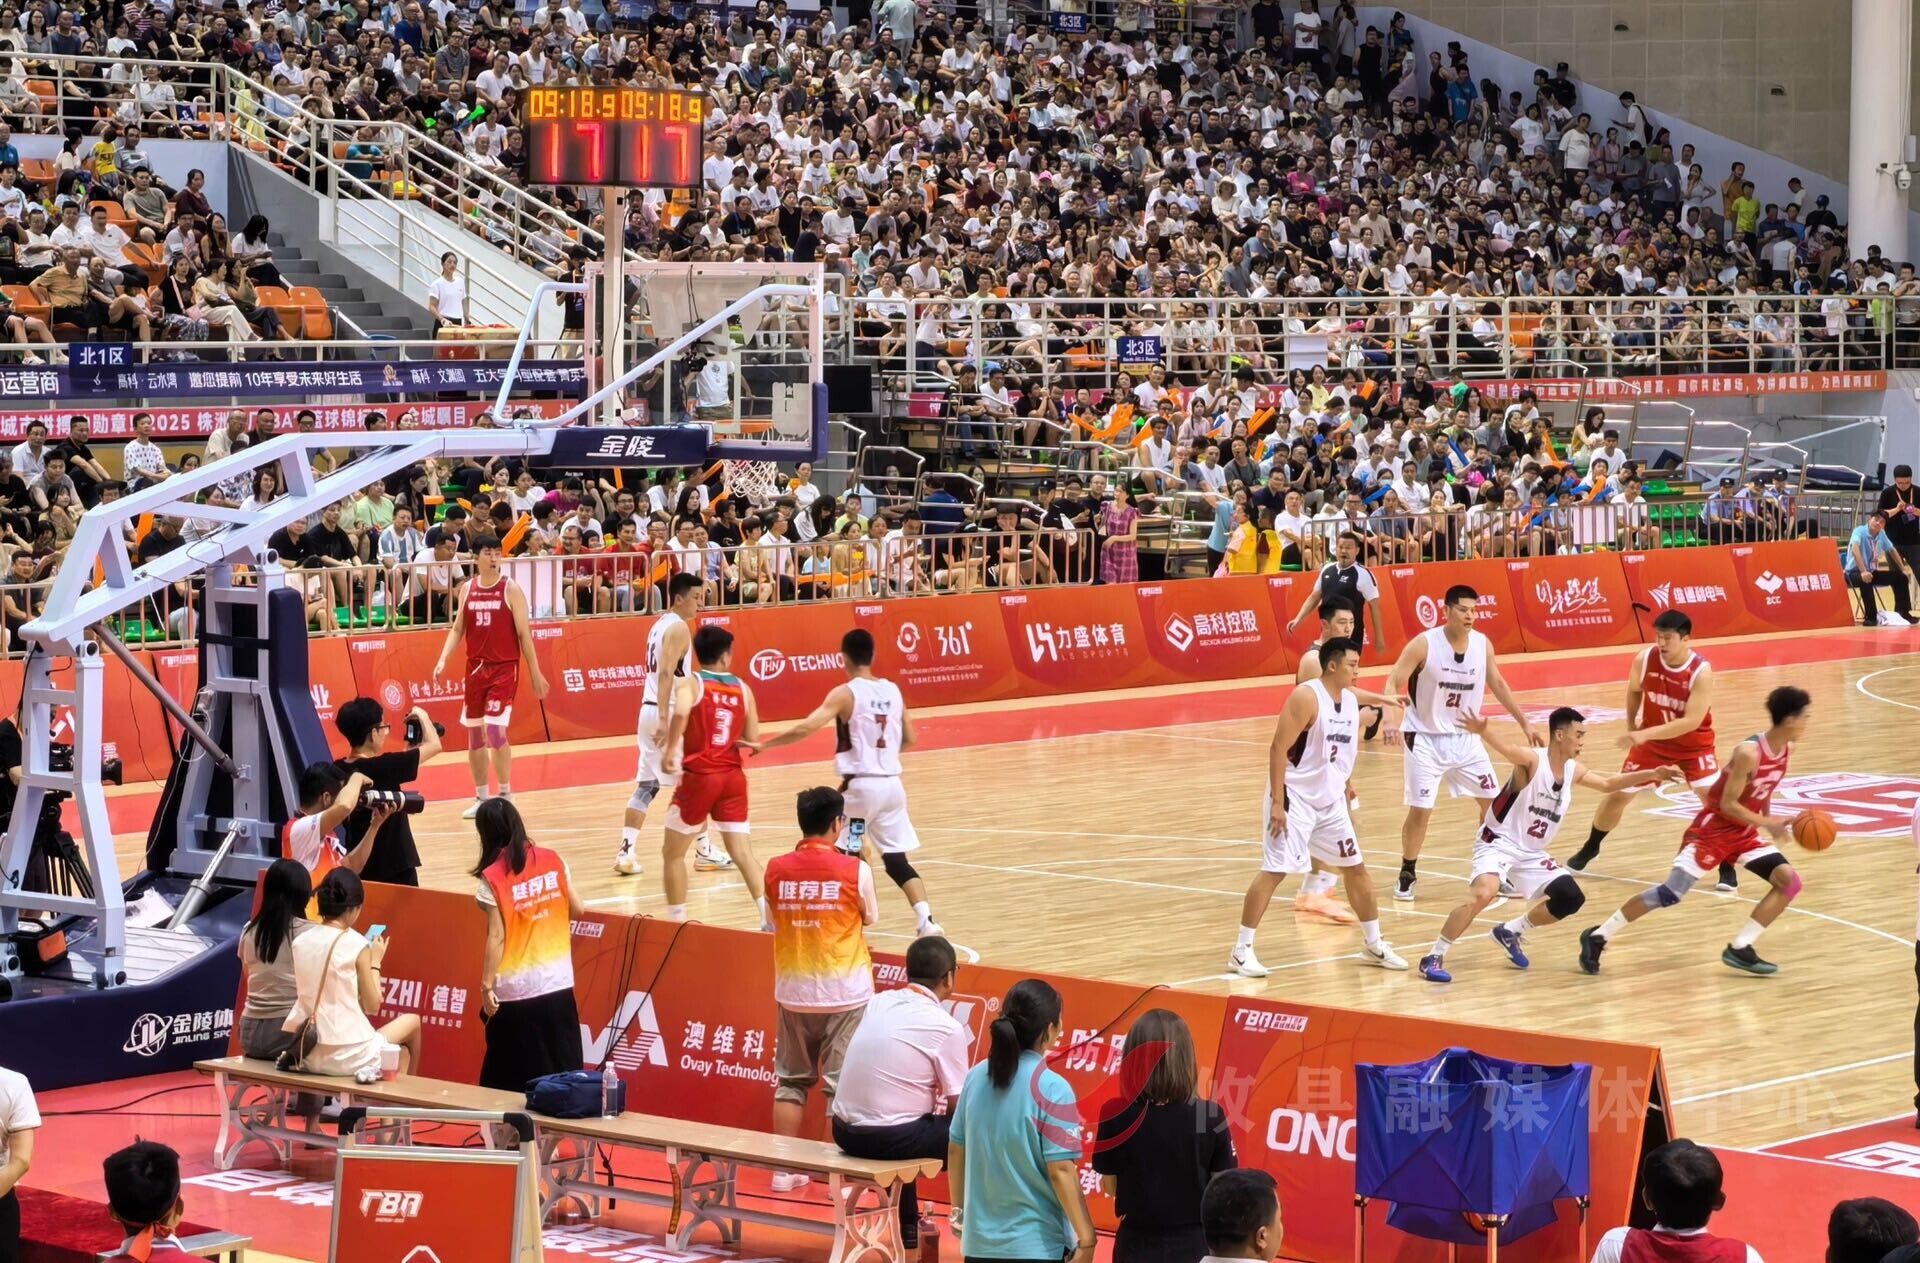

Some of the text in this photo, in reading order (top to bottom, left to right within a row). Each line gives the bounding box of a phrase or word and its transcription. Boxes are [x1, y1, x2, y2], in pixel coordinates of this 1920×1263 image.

[1059, 14, 1082, 28] 北3区
[551, 122, 688, 183] 17 17
[79, 346, 125, 365] 北1区
[1126, 338, 1156, 356] 北3区
[1, 370, 60, 396] 运营商
[189, 371, 242, 389] 邀您提前
[245, 370, 363, 388] 10年享受未来好生活
[586, 435, 666, 458] 金陵
[1193, 609, 1259, 636] 高科控股
[1056, 622, 1126, 649] 力盛体育
[1446, 692, 1462, 709] 21
[711, 708, 733, 747] 3
[1698, 753, 1717, 771] 15
[1478, 773, 1496, 790] 21
[1526, 819, 1549, 840] 23
[1336, 837, 1357, 859] 12
[778, 880, 842, 901] 推荐官
[432, 984, 468, 1015] 德智
[172, 1032, 210, 1045] JINLING
[682, 1019, 777, 1062] 澳维科
[680, 1053, 713, 1078] Ovay
